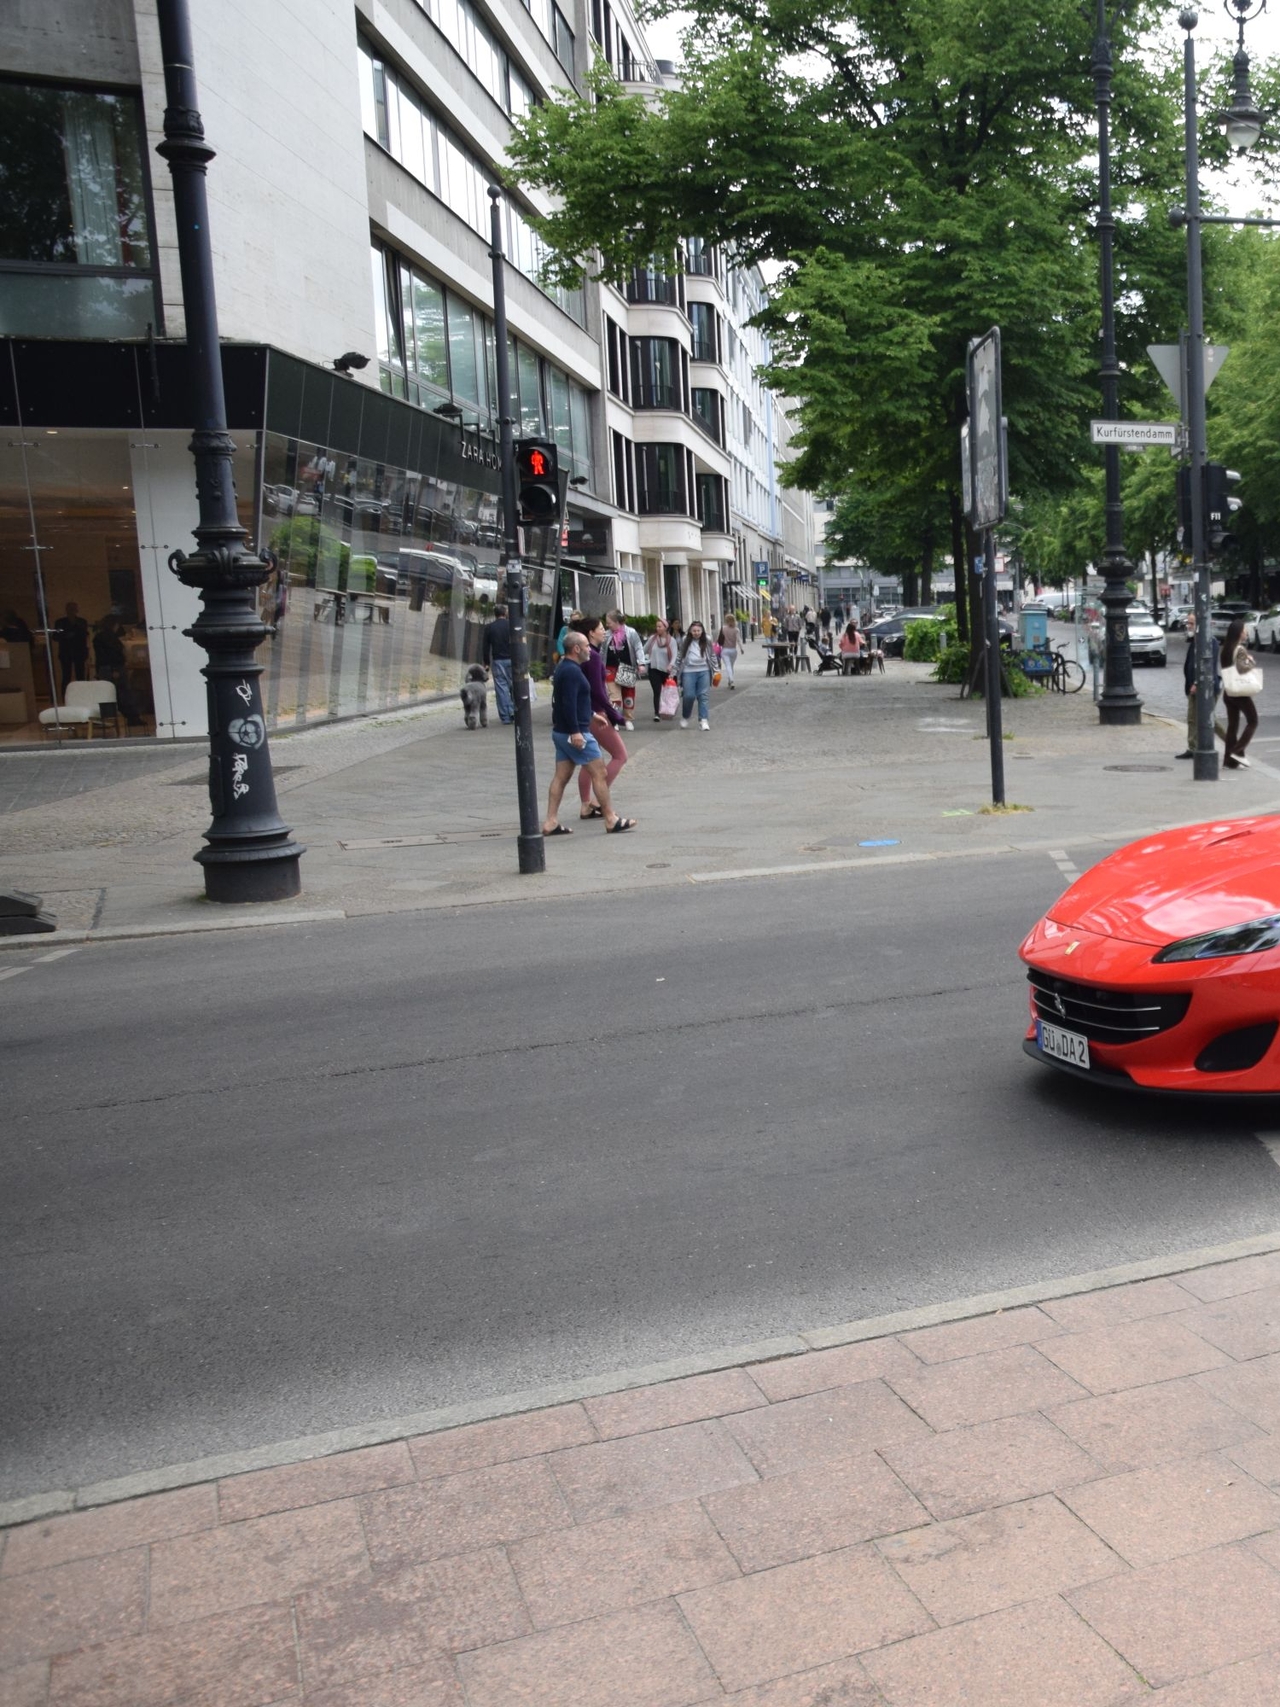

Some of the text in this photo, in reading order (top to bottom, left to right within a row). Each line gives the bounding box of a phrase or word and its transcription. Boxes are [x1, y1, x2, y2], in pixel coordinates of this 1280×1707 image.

[1096, 425, 1173, 439] Kurfürstendamm
[461, 441, 485, 465] ZARA
[1210, 512, 1221, 521] F11
[1042, 1026, 1086, 1064] GÜ DA 2
